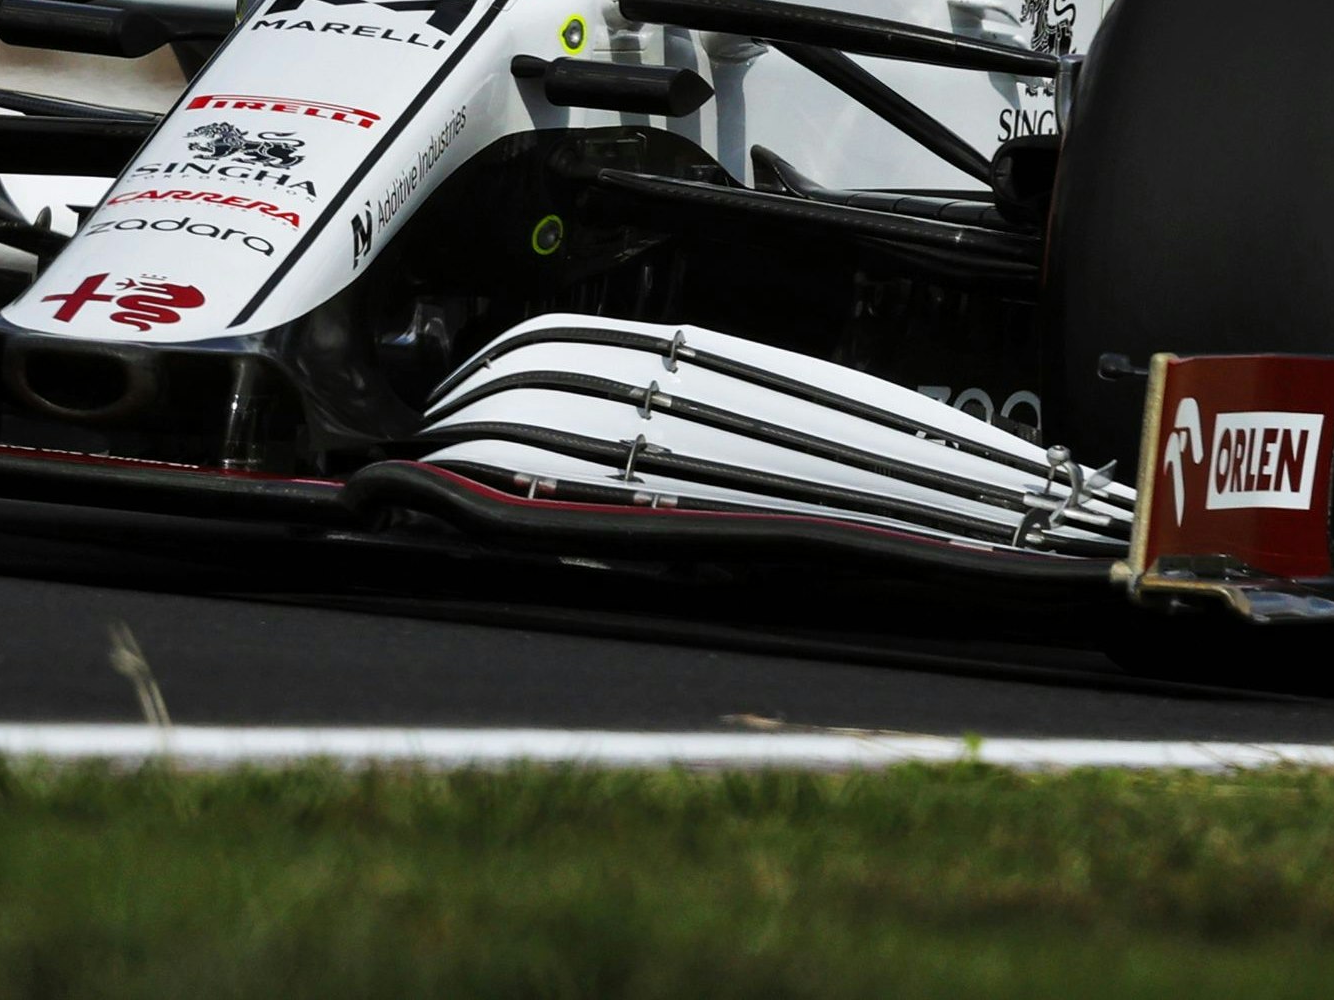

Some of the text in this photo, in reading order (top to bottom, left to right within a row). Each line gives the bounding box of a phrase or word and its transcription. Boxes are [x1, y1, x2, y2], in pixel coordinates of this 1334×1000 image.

[251, 19, 446, 51] MARELLI
[186, 94, 381, 130] PIRELLI
[997, 108, 1055, 142] SING
[135, 162, 317, 198] SINGHA
[377, 105, 468, 234] Additive Industries
[107, 189, 301, 229] CARRERA
[84, 217, 276, 257] zadara
[1215, 427, 1310, 494] ORLEN
